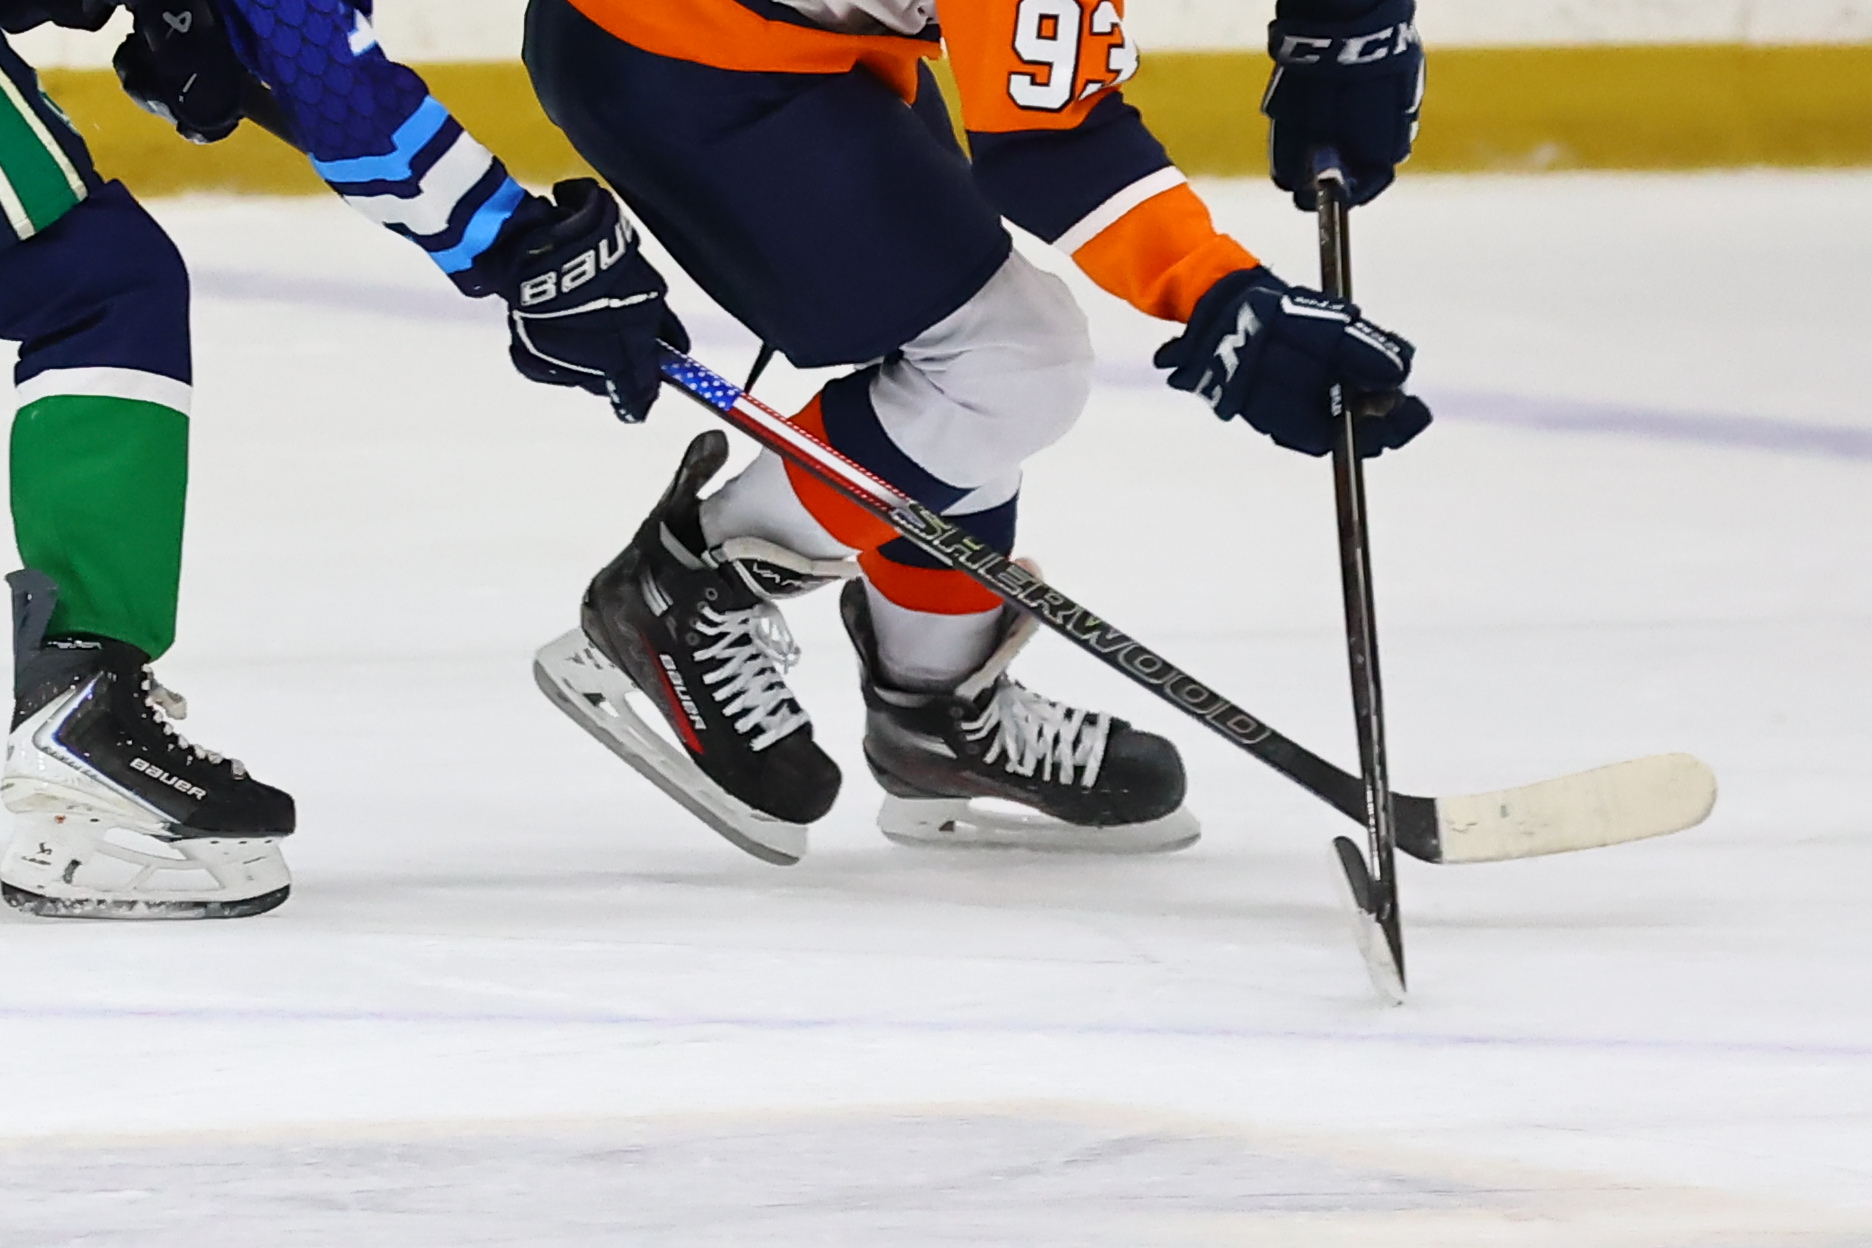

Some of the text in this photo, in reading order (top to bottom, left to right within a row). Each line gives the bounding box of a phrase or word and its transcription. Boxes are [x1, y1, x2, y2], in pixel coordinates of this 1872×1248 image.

[520, 217, 633, 306] BAU
[891, 500, 1273, 745] SHERWOOD
[659, 654, 707, 729] BAUER
[130, 758, 207, 801] BAUER
